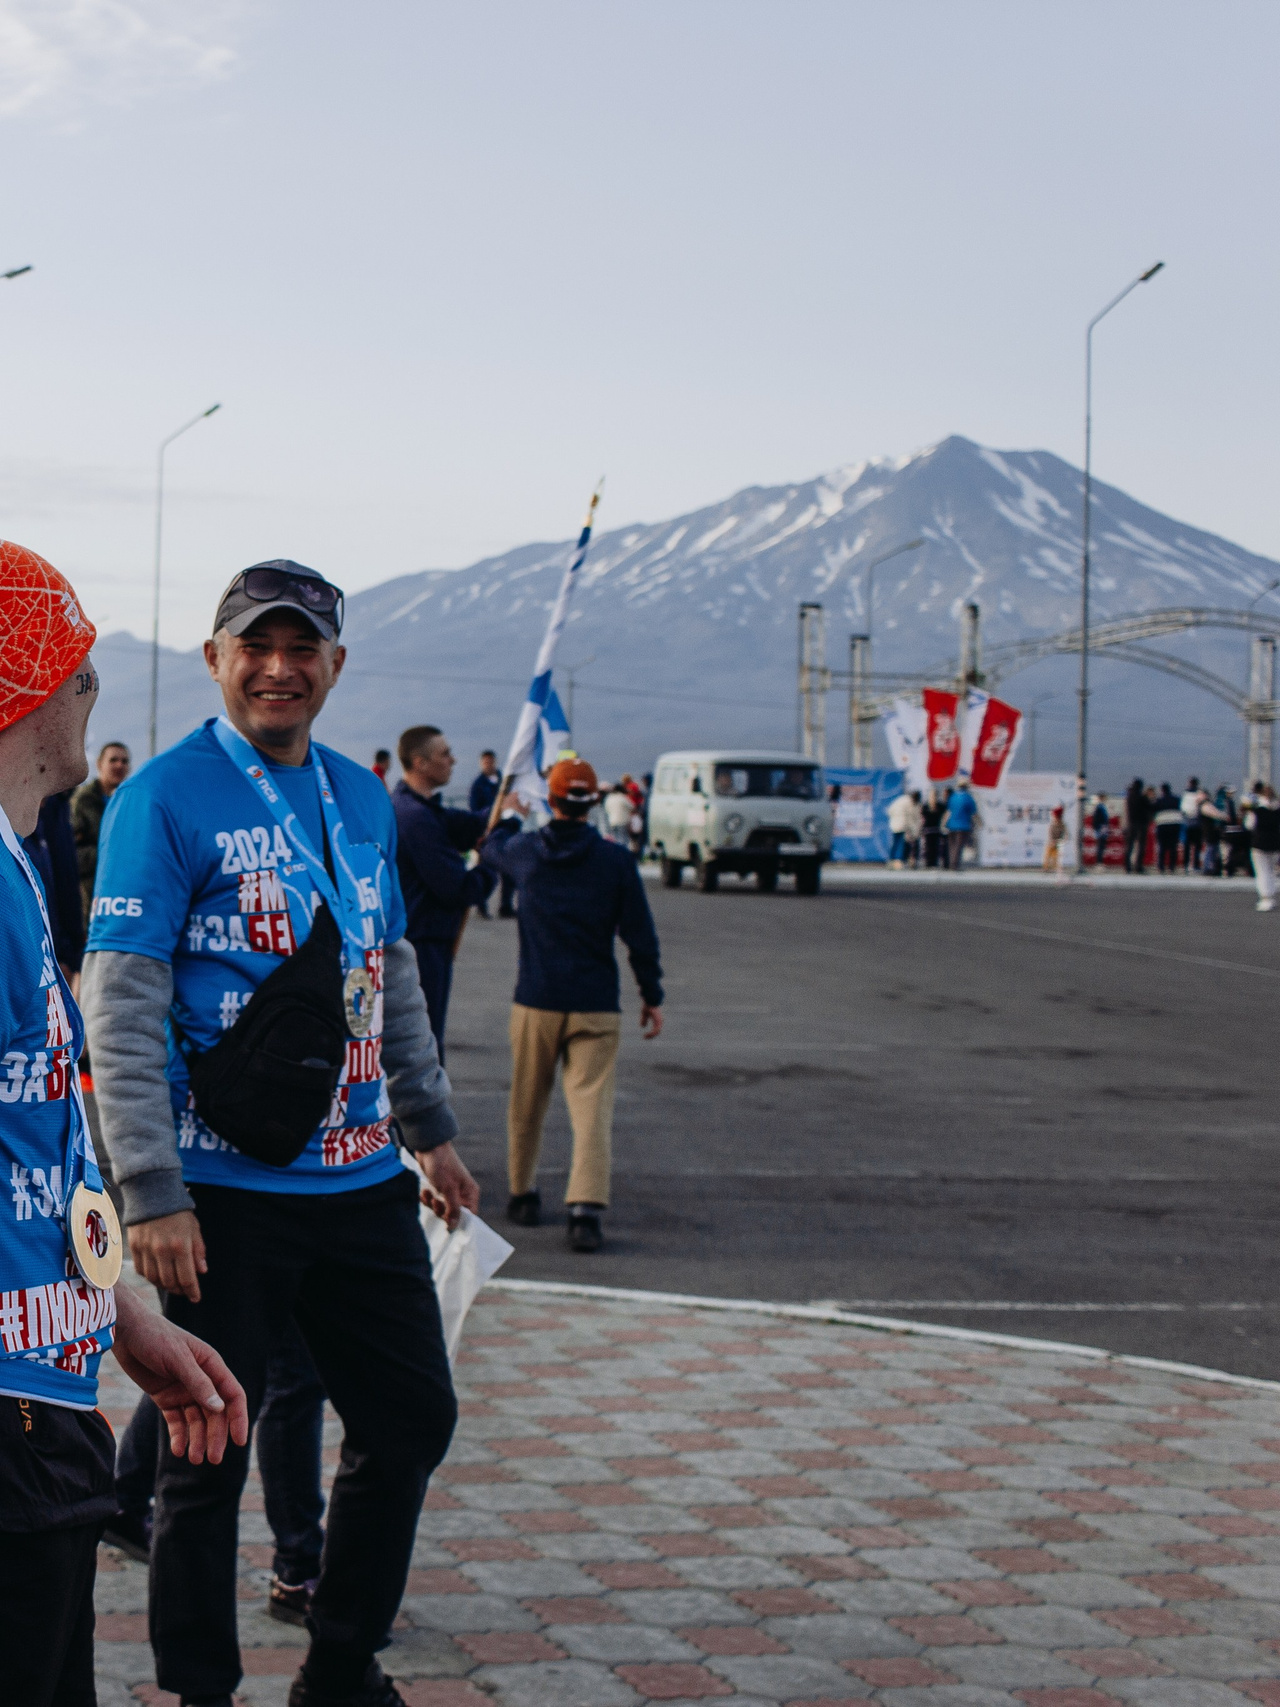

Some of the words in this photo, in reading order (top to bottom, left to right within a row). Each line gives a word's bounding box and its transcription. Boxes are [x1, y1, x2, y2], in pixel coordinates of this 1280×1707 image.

[257, 778, 279, 803] ПСБ
[215, 824, 293, 875] 2024
[97, 896, 143, 918] ПСБ
